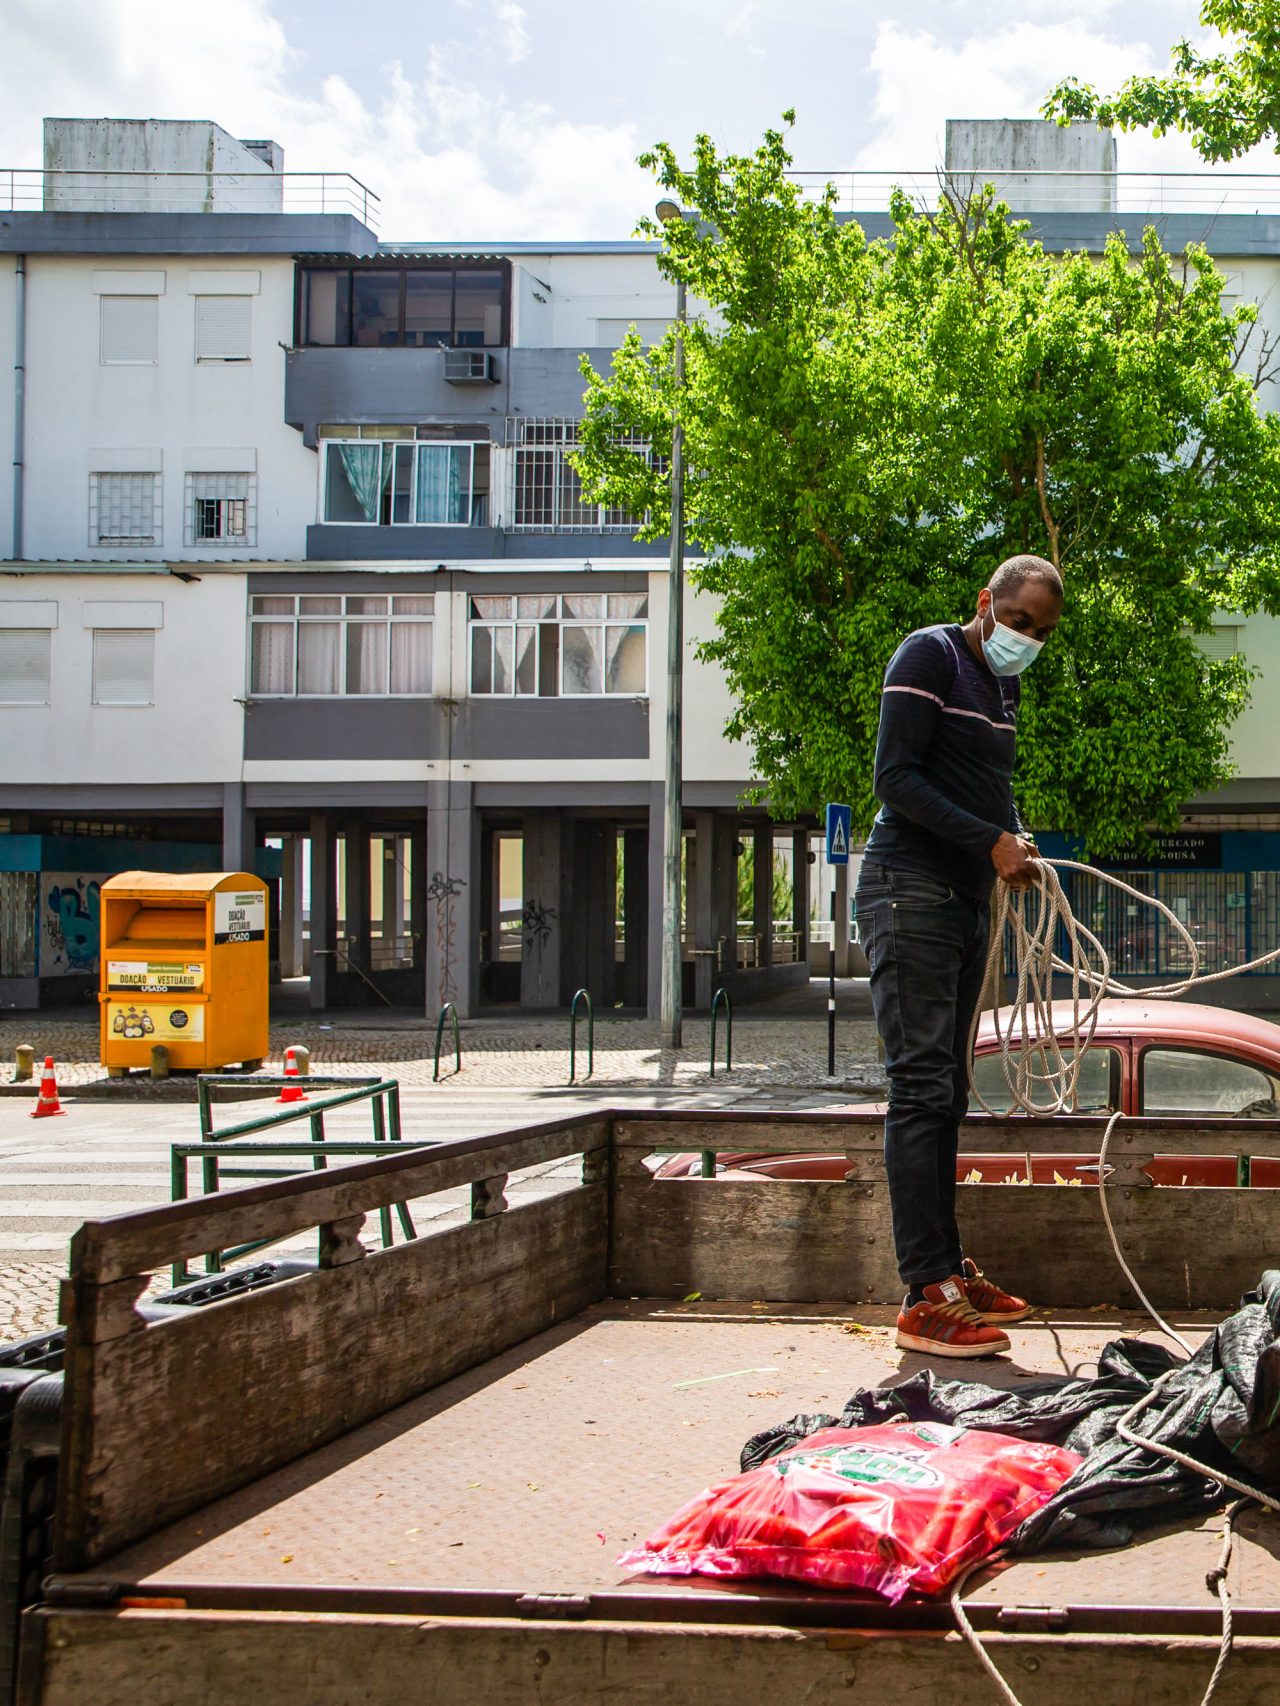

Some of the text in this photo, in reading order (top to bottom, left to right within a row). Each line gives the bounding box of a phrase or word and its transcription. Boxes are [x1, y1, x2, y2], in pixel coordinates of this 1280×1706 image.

[1153, 838, 1205, 848] MERCADO
[1160, 851, 1196, 860] SOUSA
[228, 932, 250, 943] USADO
[120, 974, 147, 984] DOAÇÃO
